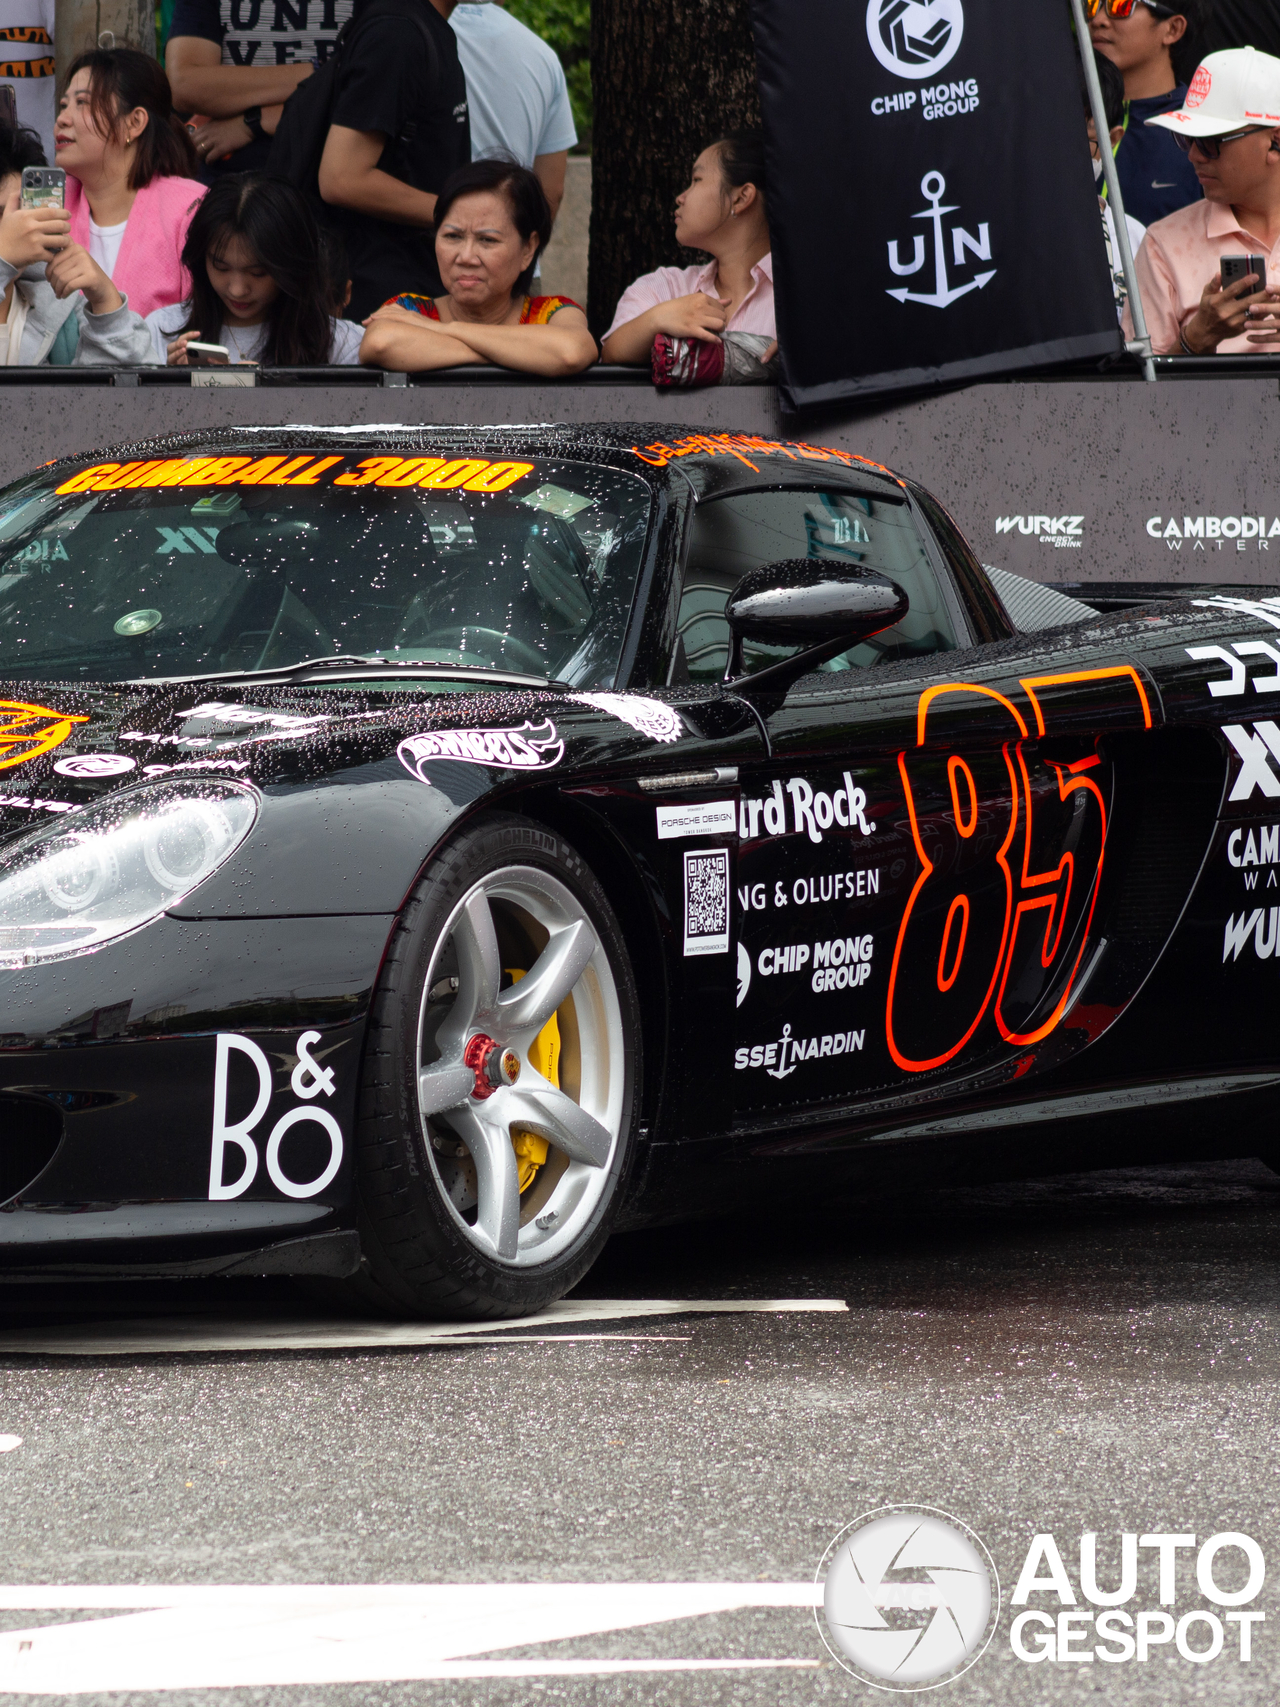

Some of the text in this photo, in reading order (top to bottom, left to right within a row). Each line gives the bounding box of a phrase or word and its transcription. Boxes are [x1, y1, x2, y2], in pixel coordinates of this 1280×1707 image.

[870, 78, 979, 115] CHIP MONG
[922, 96, 980, 120] GROUP
[55, 456, 534, 495] GUMBALL 3000
[995, 515, 1085, 535] WURKZ
[1146, 516, 1280, 538] CAMBODIA
[1054, 540, 1082, 548] DRINK
[433, 731, 542, 766] WHEELS
[661, 813, 732, 828] PORSCHE DESIGN
[790, 772, 872, 843] Rock
[886, 664, 1153, 1073] 85
[774, 881, 788, 908] &
[793, 868, 880, 905] OLUFSEN
[758, 934, 874, 976] CHIP MONG
[811, 962, 871, 993] GROUP
[790, 1019, 866, 1062] NARDIN
